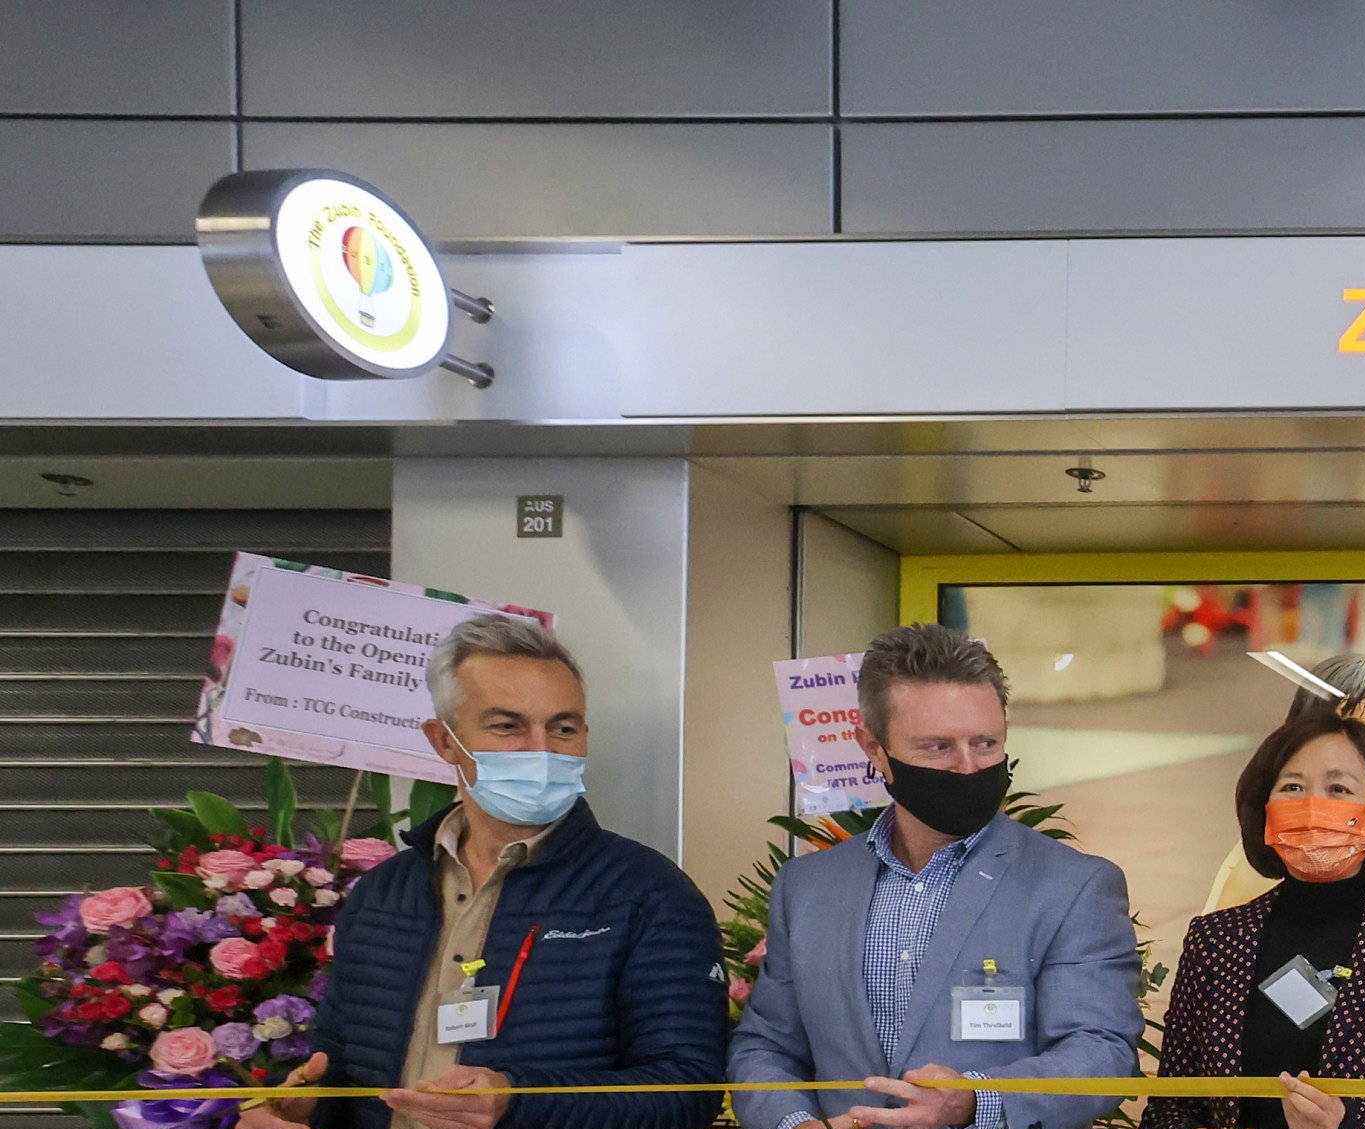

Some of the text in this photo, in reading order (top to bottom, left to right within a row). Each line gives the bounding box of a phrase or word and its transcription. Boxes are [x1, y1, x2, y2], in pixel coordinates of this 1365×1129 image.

[522, 516, 553, 532] 201
[303, 608, 440, 648] Congratulati
[293, 630, 431, 668] to the Openi
[259, 647, 423, 693] Zubin's Family
[789, 672, 846, 690] Zubin
[244, 687, 289, 707] From
[303, 697, 336, 716] TCG
[339, 704, 422, 730] Constructi
[798, 708, 862, 726] Cong
[817, 730, 856, 743] on th
[816, 761, 867, 773] Comme
